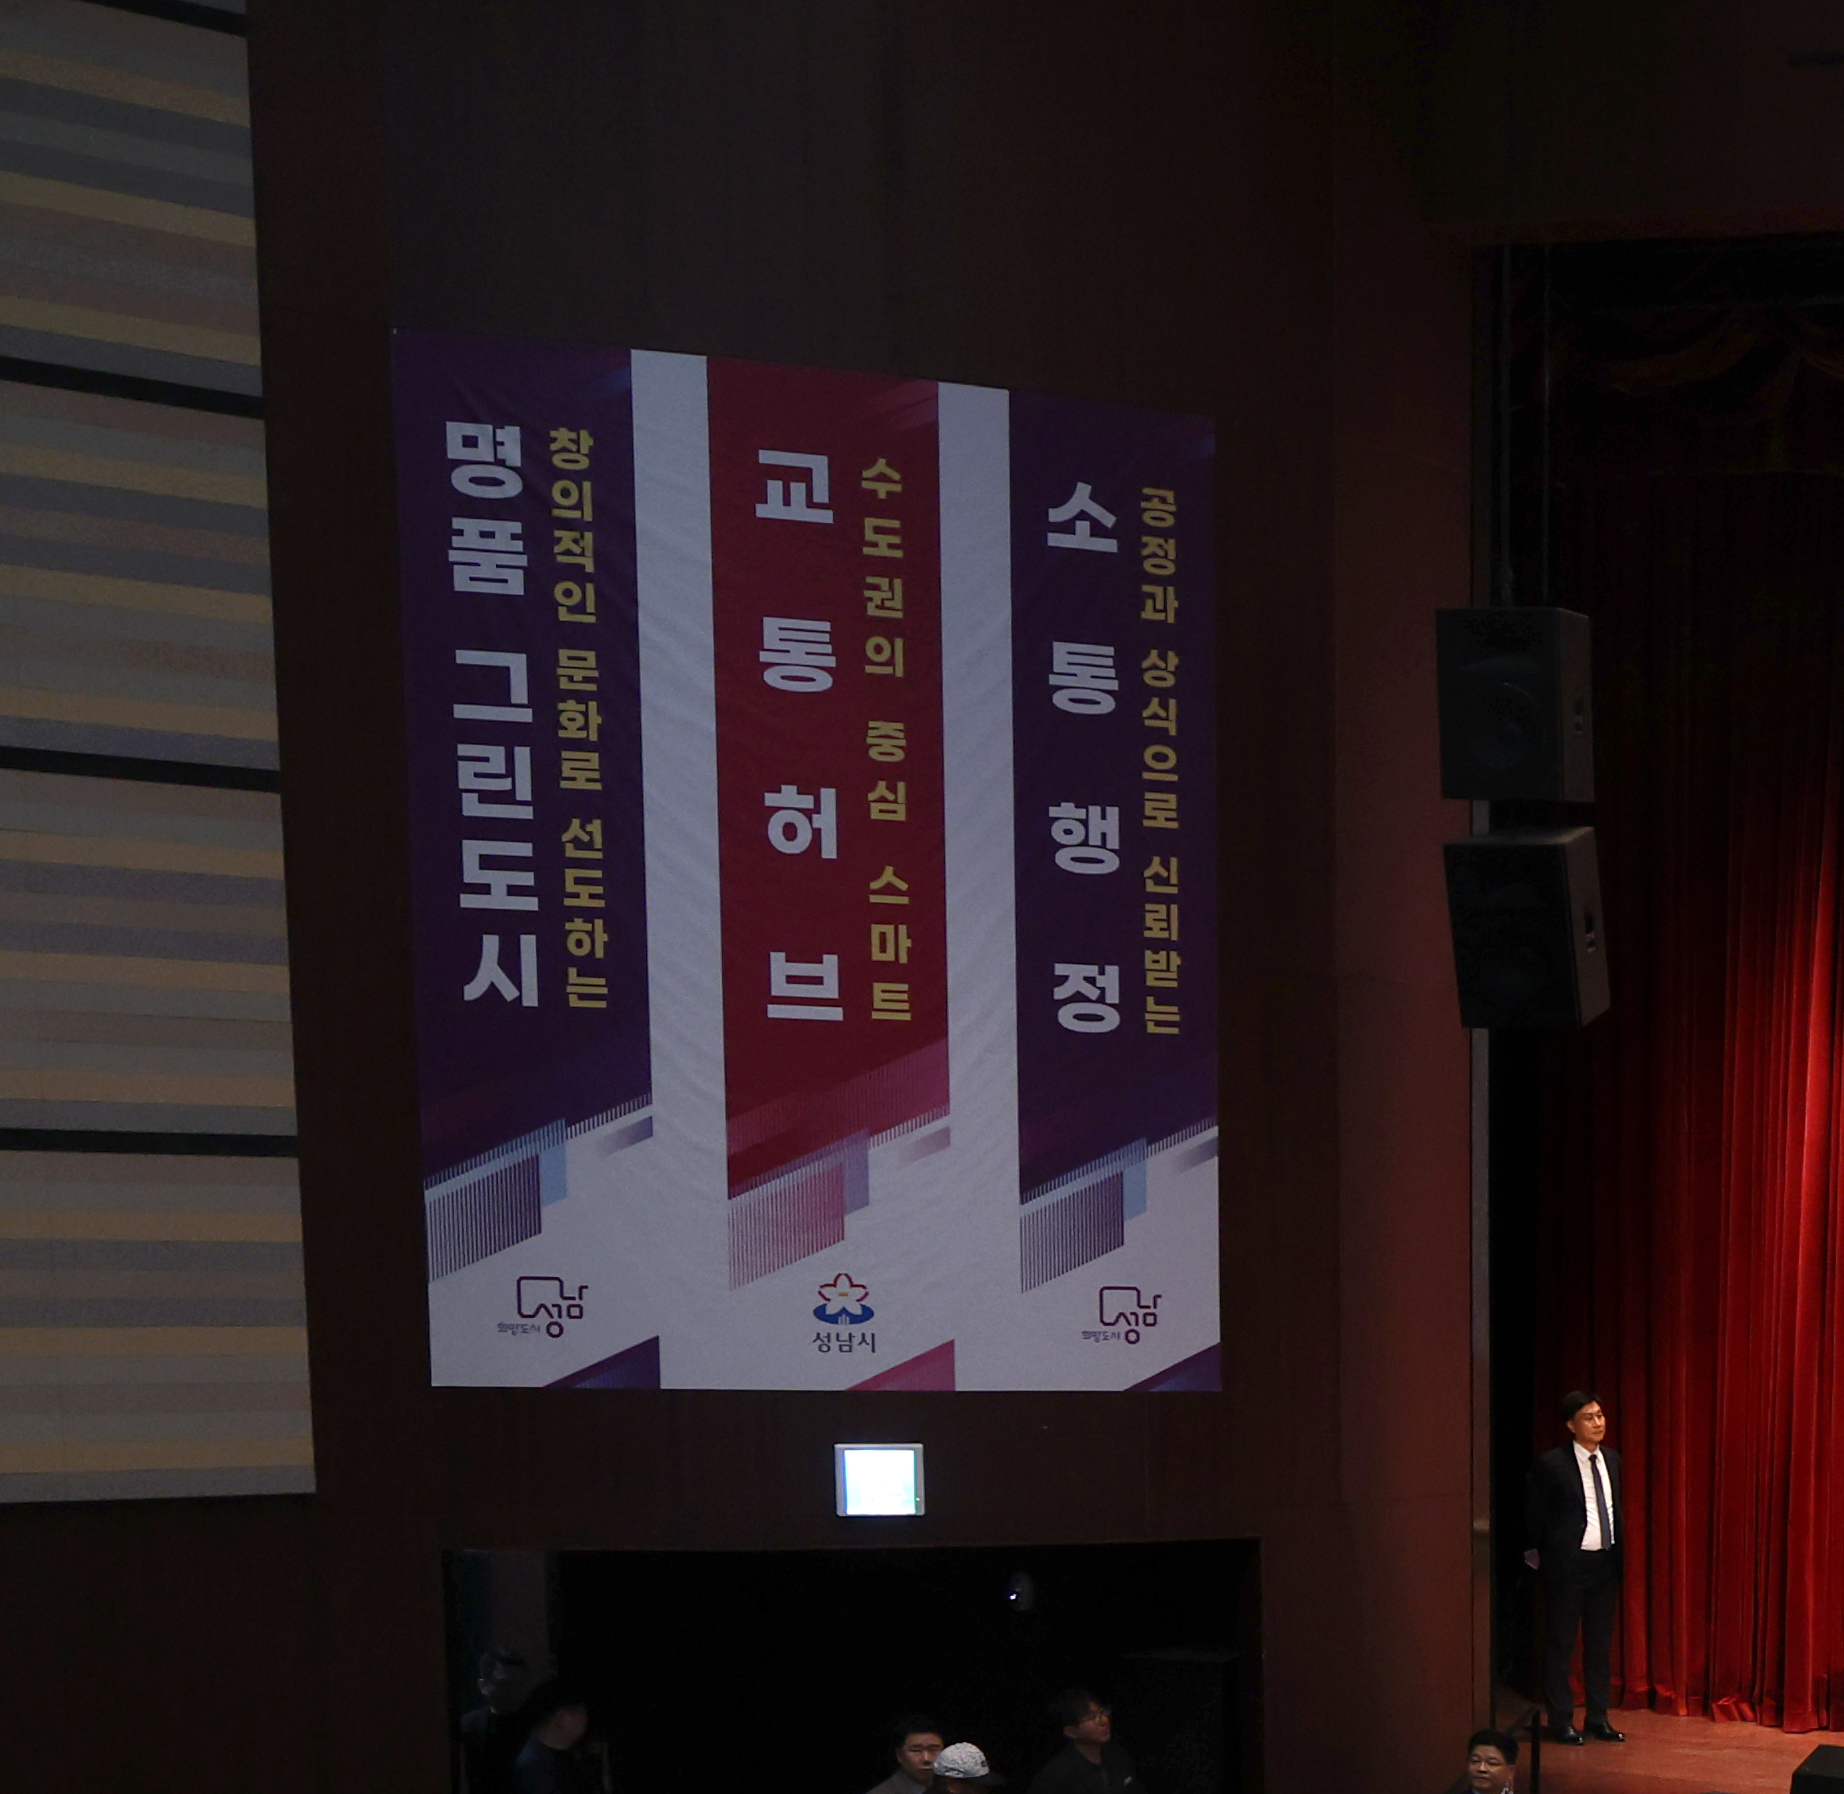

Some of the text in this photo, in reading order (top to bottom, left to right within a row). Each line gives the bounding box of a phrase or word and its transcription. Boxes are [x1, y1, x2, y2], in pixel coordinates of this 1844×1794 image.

[446, 421, 538, 1006] 명품 그린도시
[550, 428, 608, 1007] 창의적인 문화로 선도하는
[756, 450, 843, 1021] 교통허브
[862, 459, 912, 1020] 수도권의 중심 스마트
[1048, 482, 1120, 1033] 소통행정
[1141, 488, 1181, 1034] 공정과 상식으로 신뢰받는
[813, 1332, 875, 1353] 성남시
